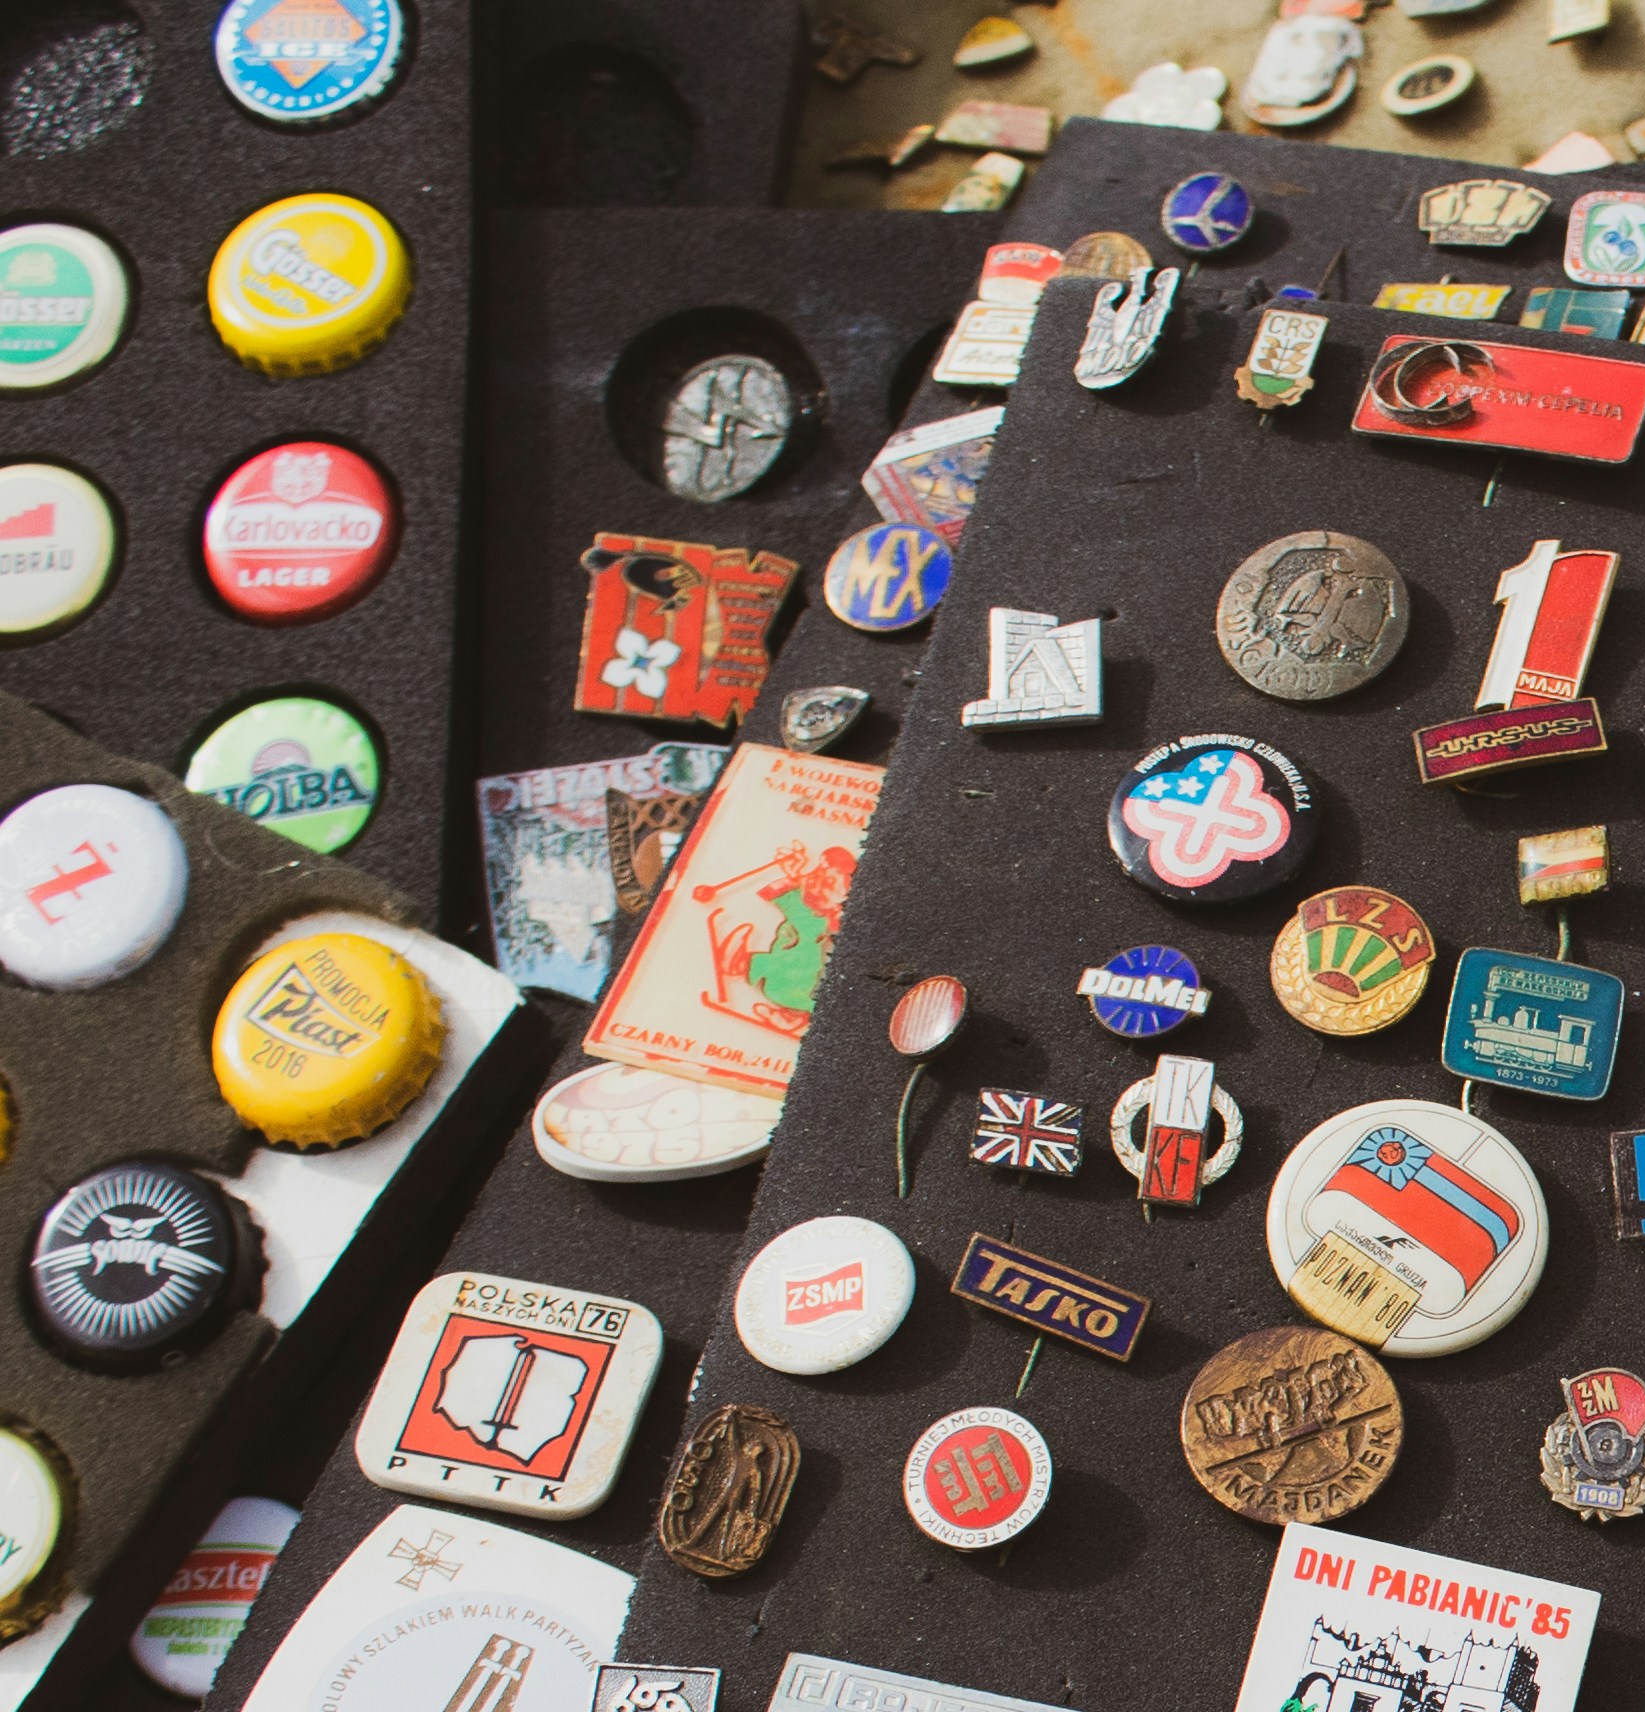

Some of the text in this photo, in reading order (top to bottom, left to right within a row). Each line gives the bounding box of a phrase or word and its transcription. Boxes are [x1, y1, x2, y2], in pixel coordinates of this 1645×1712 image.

[258, 41, 347, 58] ICE
[1266, 316, 1321, 338] CRS
[238, 567, 330, 589] LAGER
[1324, 894, 1426, 955] LZS
[305, 948, 389, 1032] PROMOCJA
[264, 981, 365, 1053] Piast
[251, 1038, 305, 1078] 2016
[458, 1280, 578, 1317] POLSKA
[786, 1276, 863, 1313] ZSMP
[1221, 1426, 1395, 1515] MAJDANEK
[362, 1603, 517, 1661] SZLAKIEM WALK
